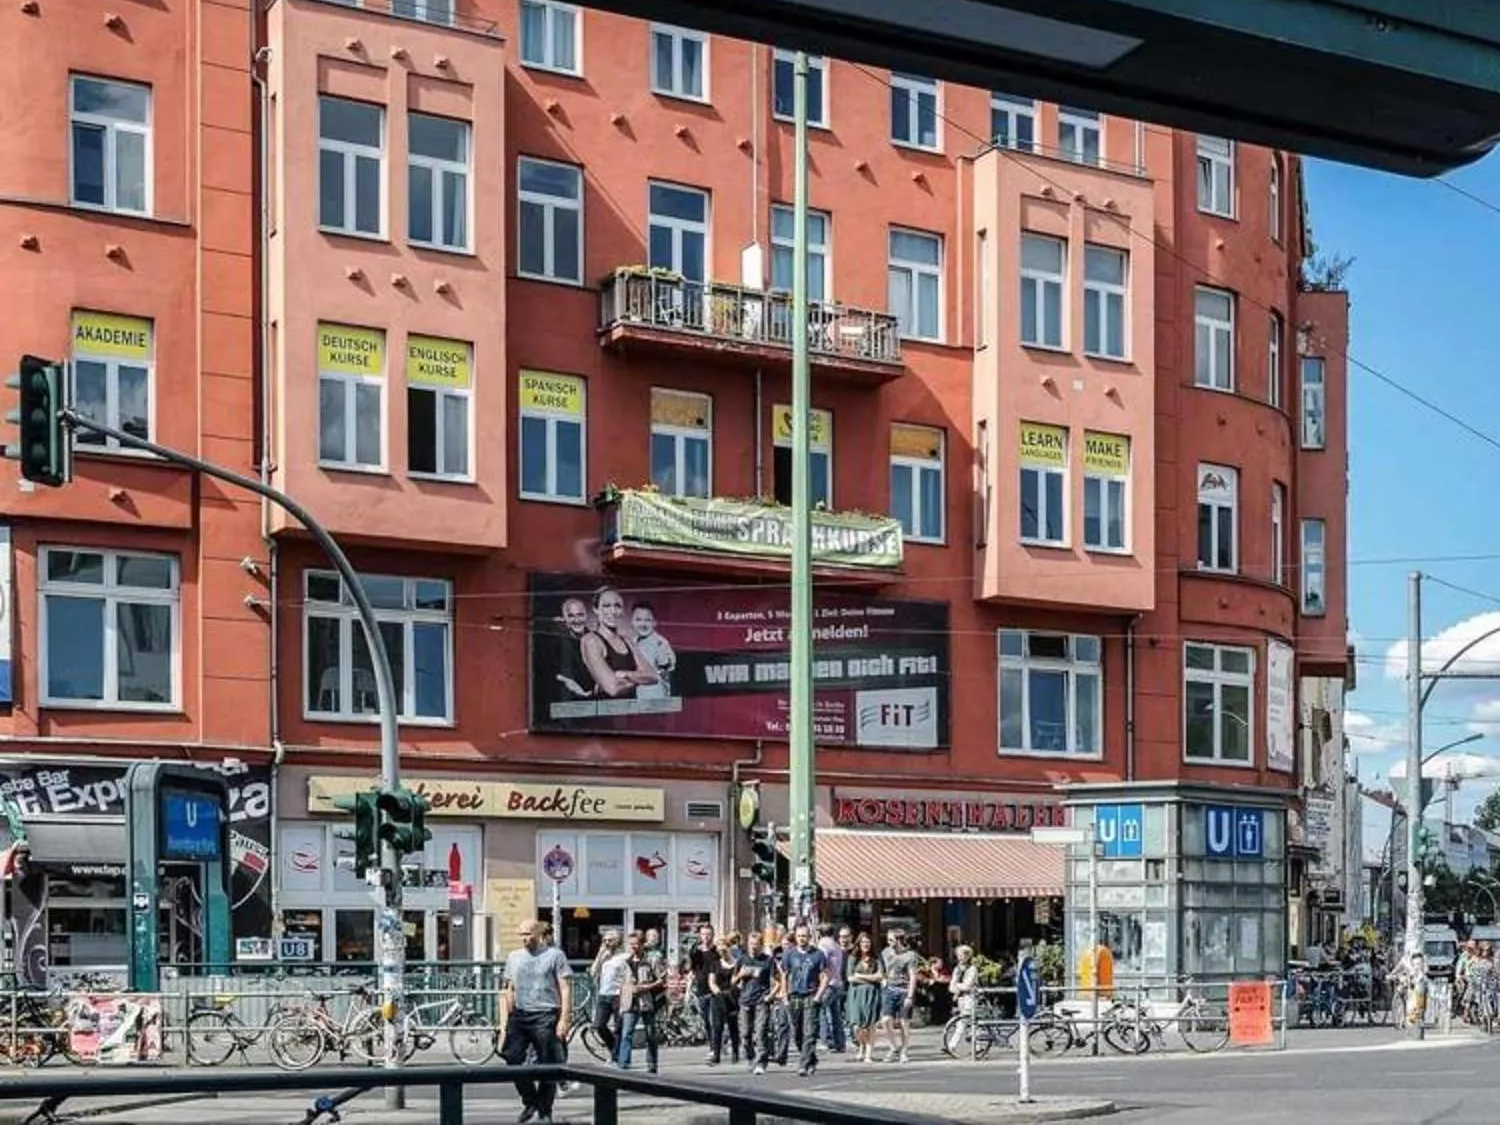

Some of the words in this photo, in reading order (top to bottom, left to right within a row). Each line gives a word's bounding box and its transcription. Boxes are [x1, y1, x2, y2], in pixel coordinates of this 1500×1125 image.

[75, 326, 146, 348] AKADEMIE
[321, 333, 378, 353] DEUTSCH
[329, 350, 370, 368] KURSE
[408, 346, 467, 365] ENGLISCH
[418, 362, 457, 379] KURSE
[524, 378, 577, 396] SPANISCH
[533, 392, 569, 409] KURSE
[1021, 430, 1063, 450] LEARN
[1085, 439, 1122, 458] MAKE
[736, 516, 898, 556] SPRAHKURSE
[745, 628, 783, 643] Jetzt
[46, 779, 129, 812] Expr
[507, 788, 606, 818] Backfee
[186, 801, 197, 828] U
[1099, 818, 1115, 842] U
[1206, 816, 1231, 853] U
[283, 941, 308, 956] U8
